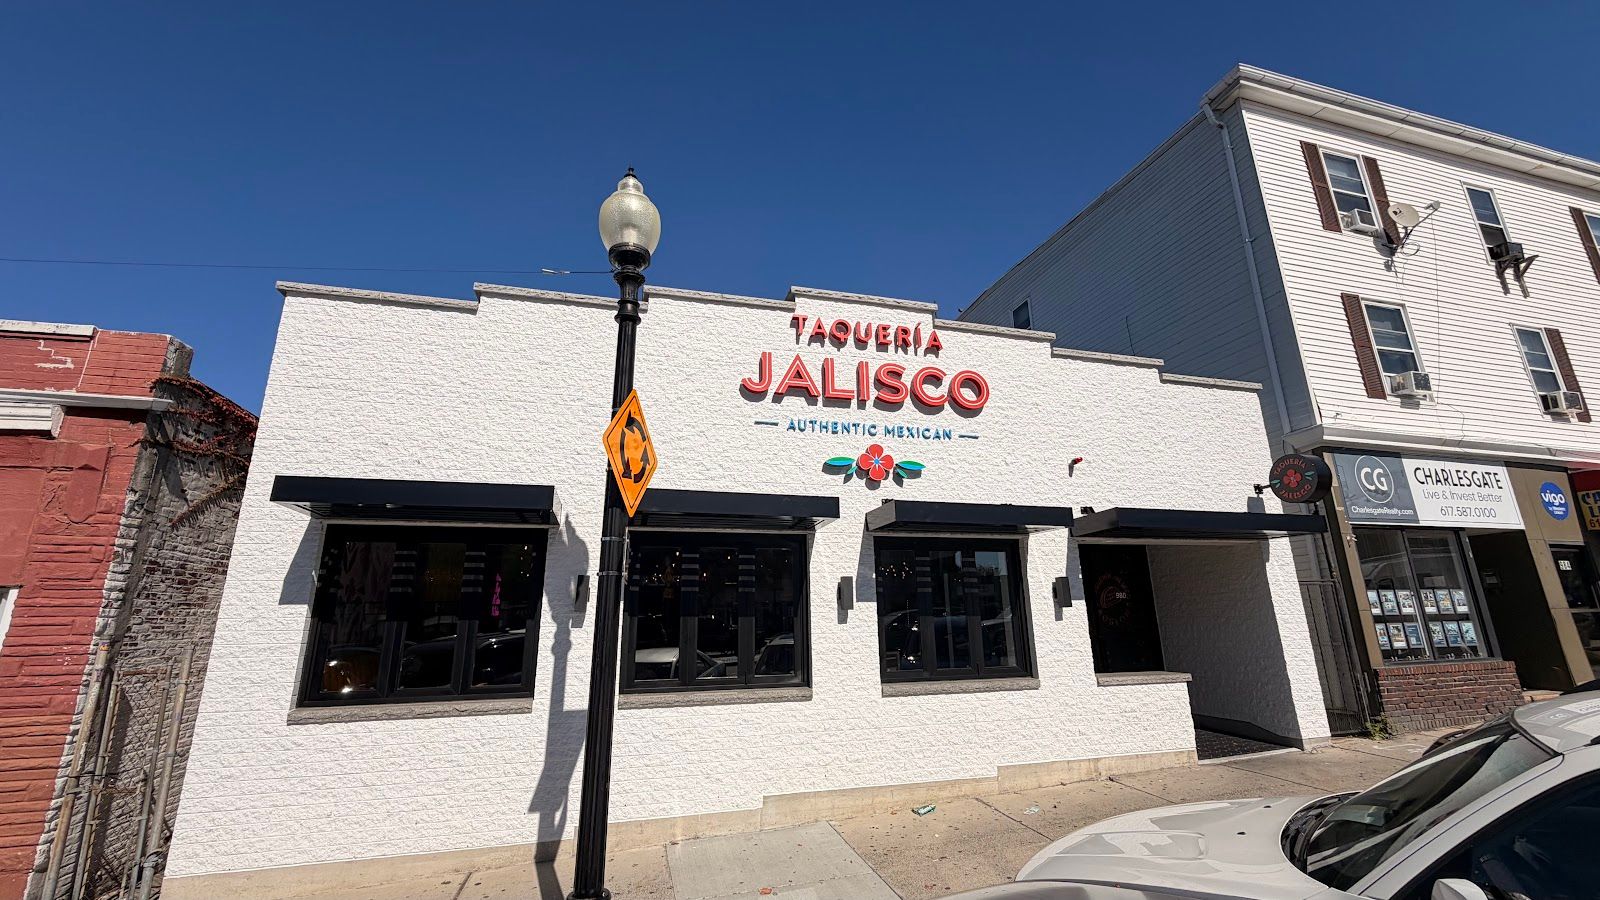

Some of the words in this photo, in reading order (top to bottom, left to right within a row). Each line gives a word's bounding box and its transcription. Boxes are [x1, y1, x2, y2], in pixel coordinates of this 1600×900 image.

[792, 314, 943, 351] TAQUERÍA
[740, 351, 990, 410] JALISCO
[787, 418, 878, 436] AUTHENTIC
[884, 425, 953, 440] MEXICAN
[1360, 467, 1388, 491] CG
[1413, 467, 1504, 490] CHARLESGATE
[1280, 484, 1312, 499] JALISCO
[1423, 488, 1440, 500] Live
[1441, 490, 1450, 501] &
[1450, 488, 1476, 502] Invest
[1476, 492, 1503, 503] Better
[1541, 489, 1566, 506] vigo
[1351, 505, 1414, 517] CharlesgateRealty.com
[1440, 505, 1497, 518] 617.587.0100
